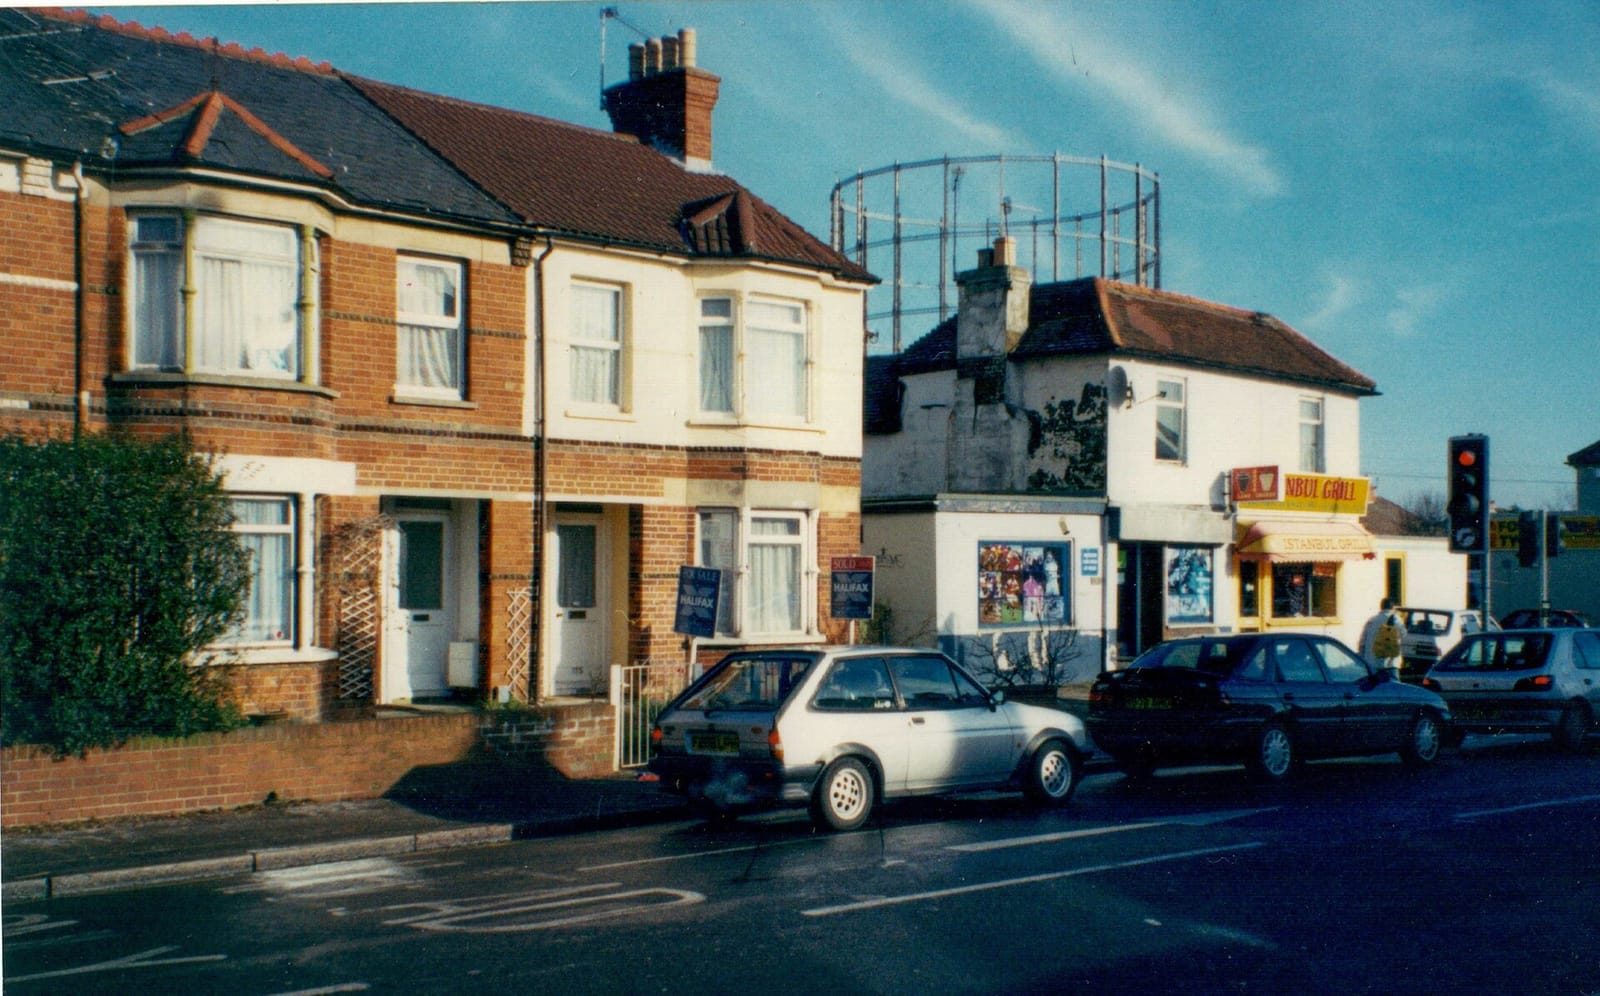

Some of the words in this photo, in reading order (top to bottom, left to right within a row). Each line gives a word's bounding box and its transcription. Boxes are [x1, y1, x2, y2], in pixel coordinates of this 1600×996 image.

[1322, 480, 1356, 501] GRILL
[1283, 538, 1336, 550] ISTANBUL
[833, 559, 857, 569] SOLD
[833, 583, 869, 593] HALIFAX
[680, 594, 715, 609] HALIFAX
